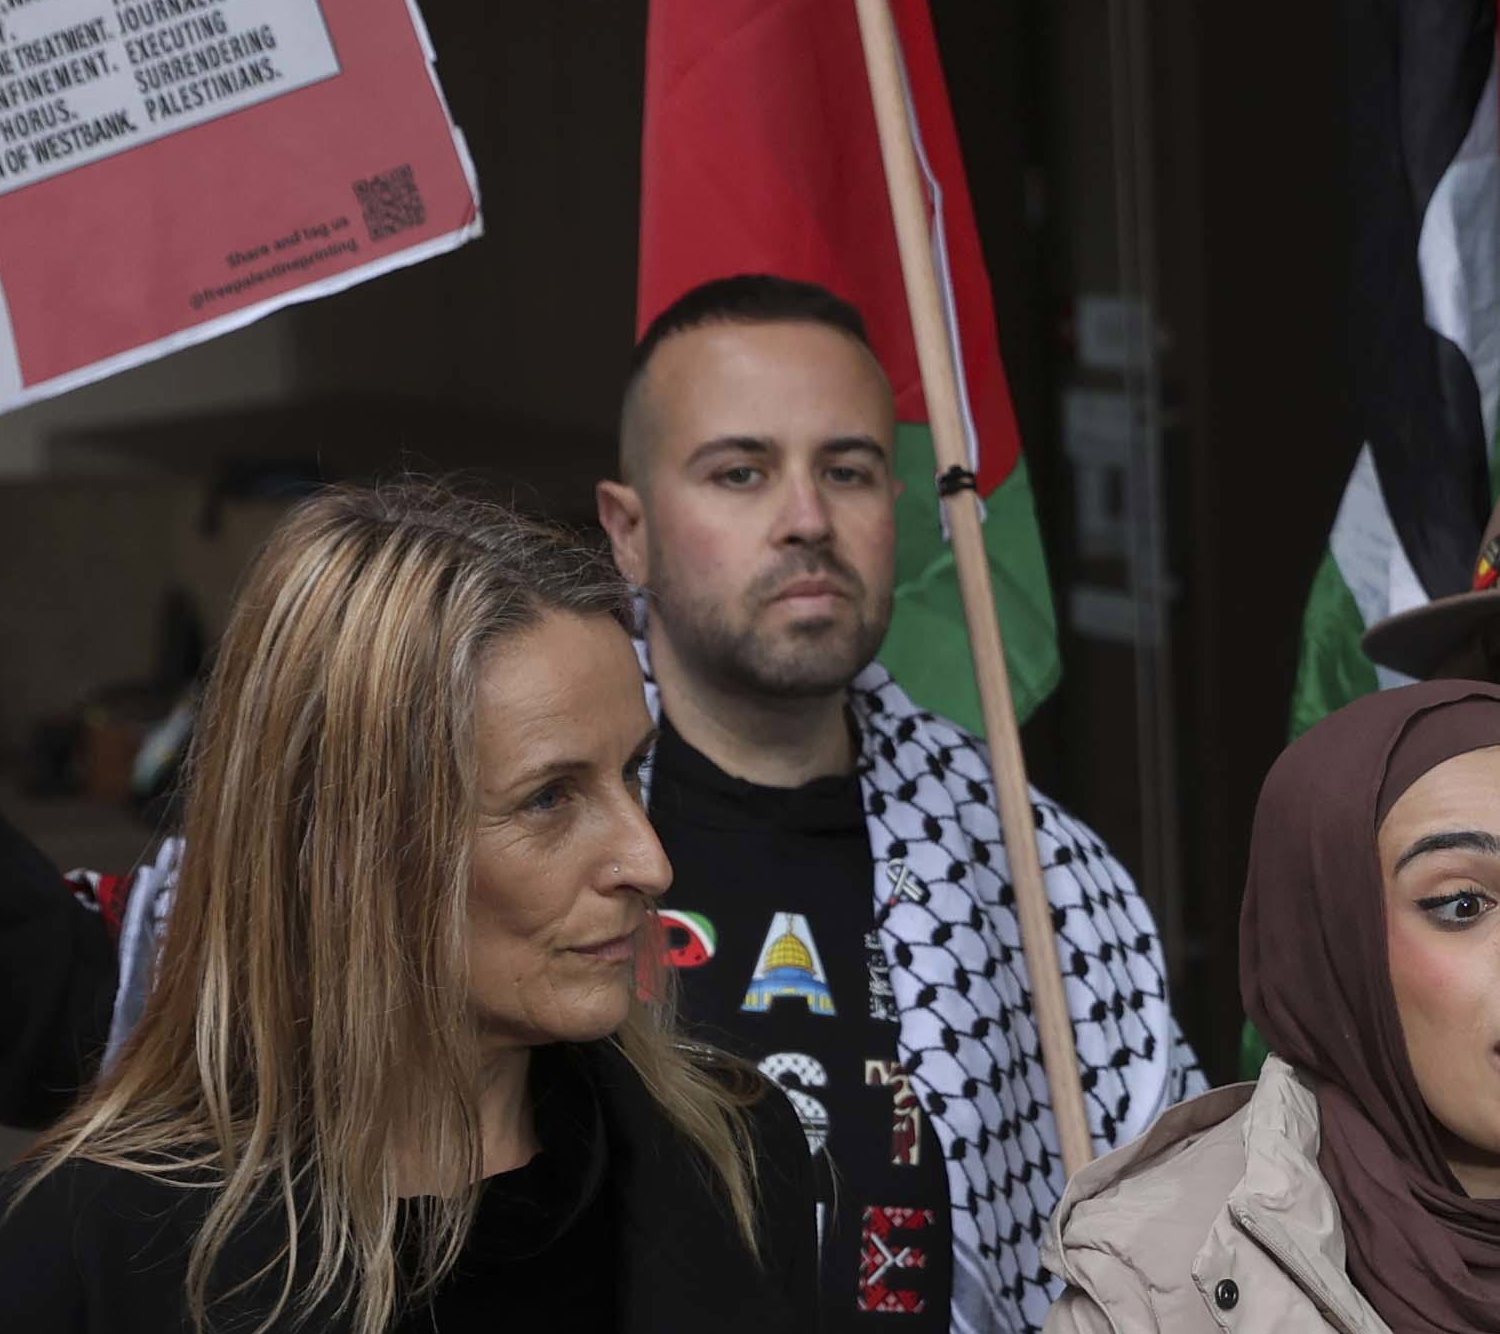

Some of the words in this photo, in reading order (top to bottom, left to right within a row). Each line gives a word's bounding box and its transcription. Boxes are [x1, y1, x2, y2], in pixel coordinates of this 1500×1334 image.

[124, 10, 228, 66] EXECUTING
[134, 25, 276, 94] SURRENDERING
[144, 57, 282, 122] PALESTINIANS.
[4, 145, 30, 174] OF
